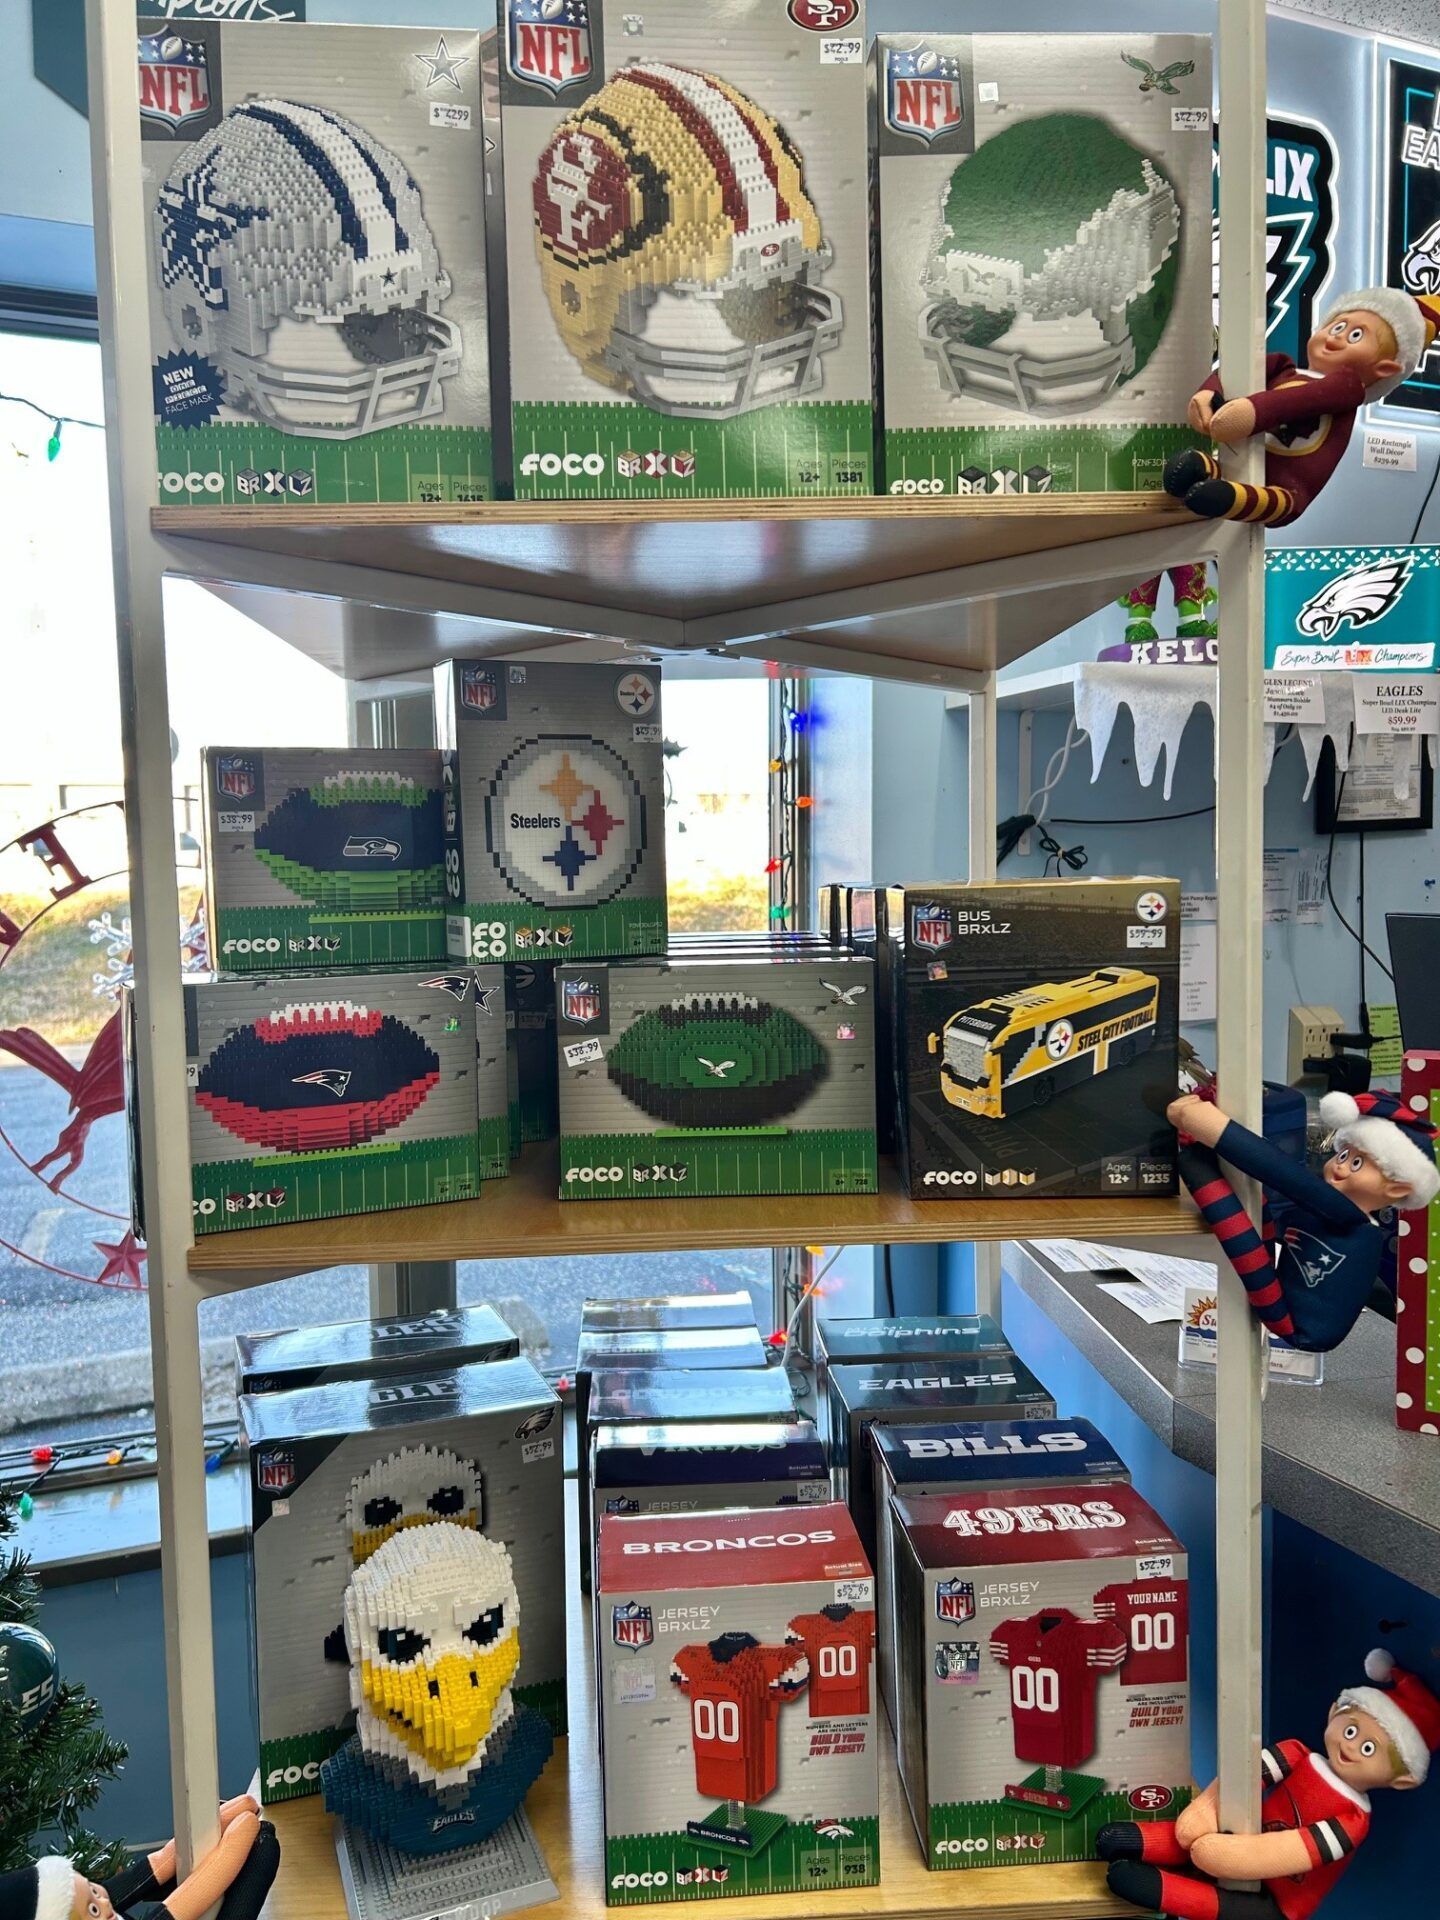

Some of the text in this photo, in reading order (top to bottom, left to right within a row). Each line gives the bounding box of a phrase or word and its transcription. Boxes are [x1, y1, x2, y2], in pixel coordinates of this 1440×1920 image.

[520, 24, 588, 80] NFL
[139, 65, 209, 117] NFL
[896, 80, 960, 129] NFL
[162, 366, 194, 386] NEW
[165, 402, 189, 415] FACE
[189, 393, 214, 407] MASK
[519, 453, 605, 476] FOCO
[796, 458, 866, 471] Ages Pieces
[798, 472, 864, 483] 12+ 1381
[890, 478, 945, 494] FOCO
[418, 481, 487, 492] Ages Pieces
[1280, 650, 1310, 665] Super
[1311, 650, 1343, 665] Bowl
[1375, 648, 1428, 665] Champions
[464, 683, 497, 710] NFL
[1376, 685, 1424, 697] EAGLES
[1362, 699, 1378, 707] Super
[1387, 716, 1417, 725] $59.99
[223, 771, 256, 797] NFL
[510, 813, 560, 830] Steelers
[958, 911, 991, 921] BUS
[918, 921, 951, 943] NFL
[222, 938, 281, 954] FOCO
[567, 994, 600, 1020] NFL
[1077, 1007, 1154, 1051] STEEL CITY FOOTBALL
[565, 1166, 624, 1183] FOCO
[1107, 1162, 1172, 1174] Ages Pieces
[923, 1171, 978, 1185] FOCO
[1108, 1174, 1170, 1184] 12+ 1235
[858, 1373, 1017, 1390] EAGLES
[902, 1431, 1088, 1460] BILLS
[262, 1463, 295, 1486] NFL
[647, 1501, 698, 1511] JERSEY
[942, 1500, 1127, 1537] 49ERS
[622, 1530, 837, 1554] BRONCOS
[1139, 1558, 1171, 1571] $52.99
[979, 1580, 1040, 1595] JERSEY
[657, 1606, 721, 1620] JERSEY
[940, 1595, 973, 1619] NFL
[618, 1620, 651, 1643] NFL
[1131, 1612, 1175, 1651] 00
[819, 1645, 857, 1678] 00
[1012, 1665, 1059, 1713] 00
[1131, 1705, 1183, 1717] BUILD YOUR
[694, 1699, 739, 1743] 00
[1129, 1715, 1183, 1728] OWN JERSEY!
[810, 1733, 842, 1746] BUILD
[431, 1809, 477, 1834] EAGLES
[700, 1830, 737, 1843] BRONCOS
[934, 1838, 989, 1855] FOCO
[805, 1852, 871, 1866] Ages Pieces
[808, 1864, 867, 1877] 12+ 938
[611, 1871, 668, 1890] FOCO
